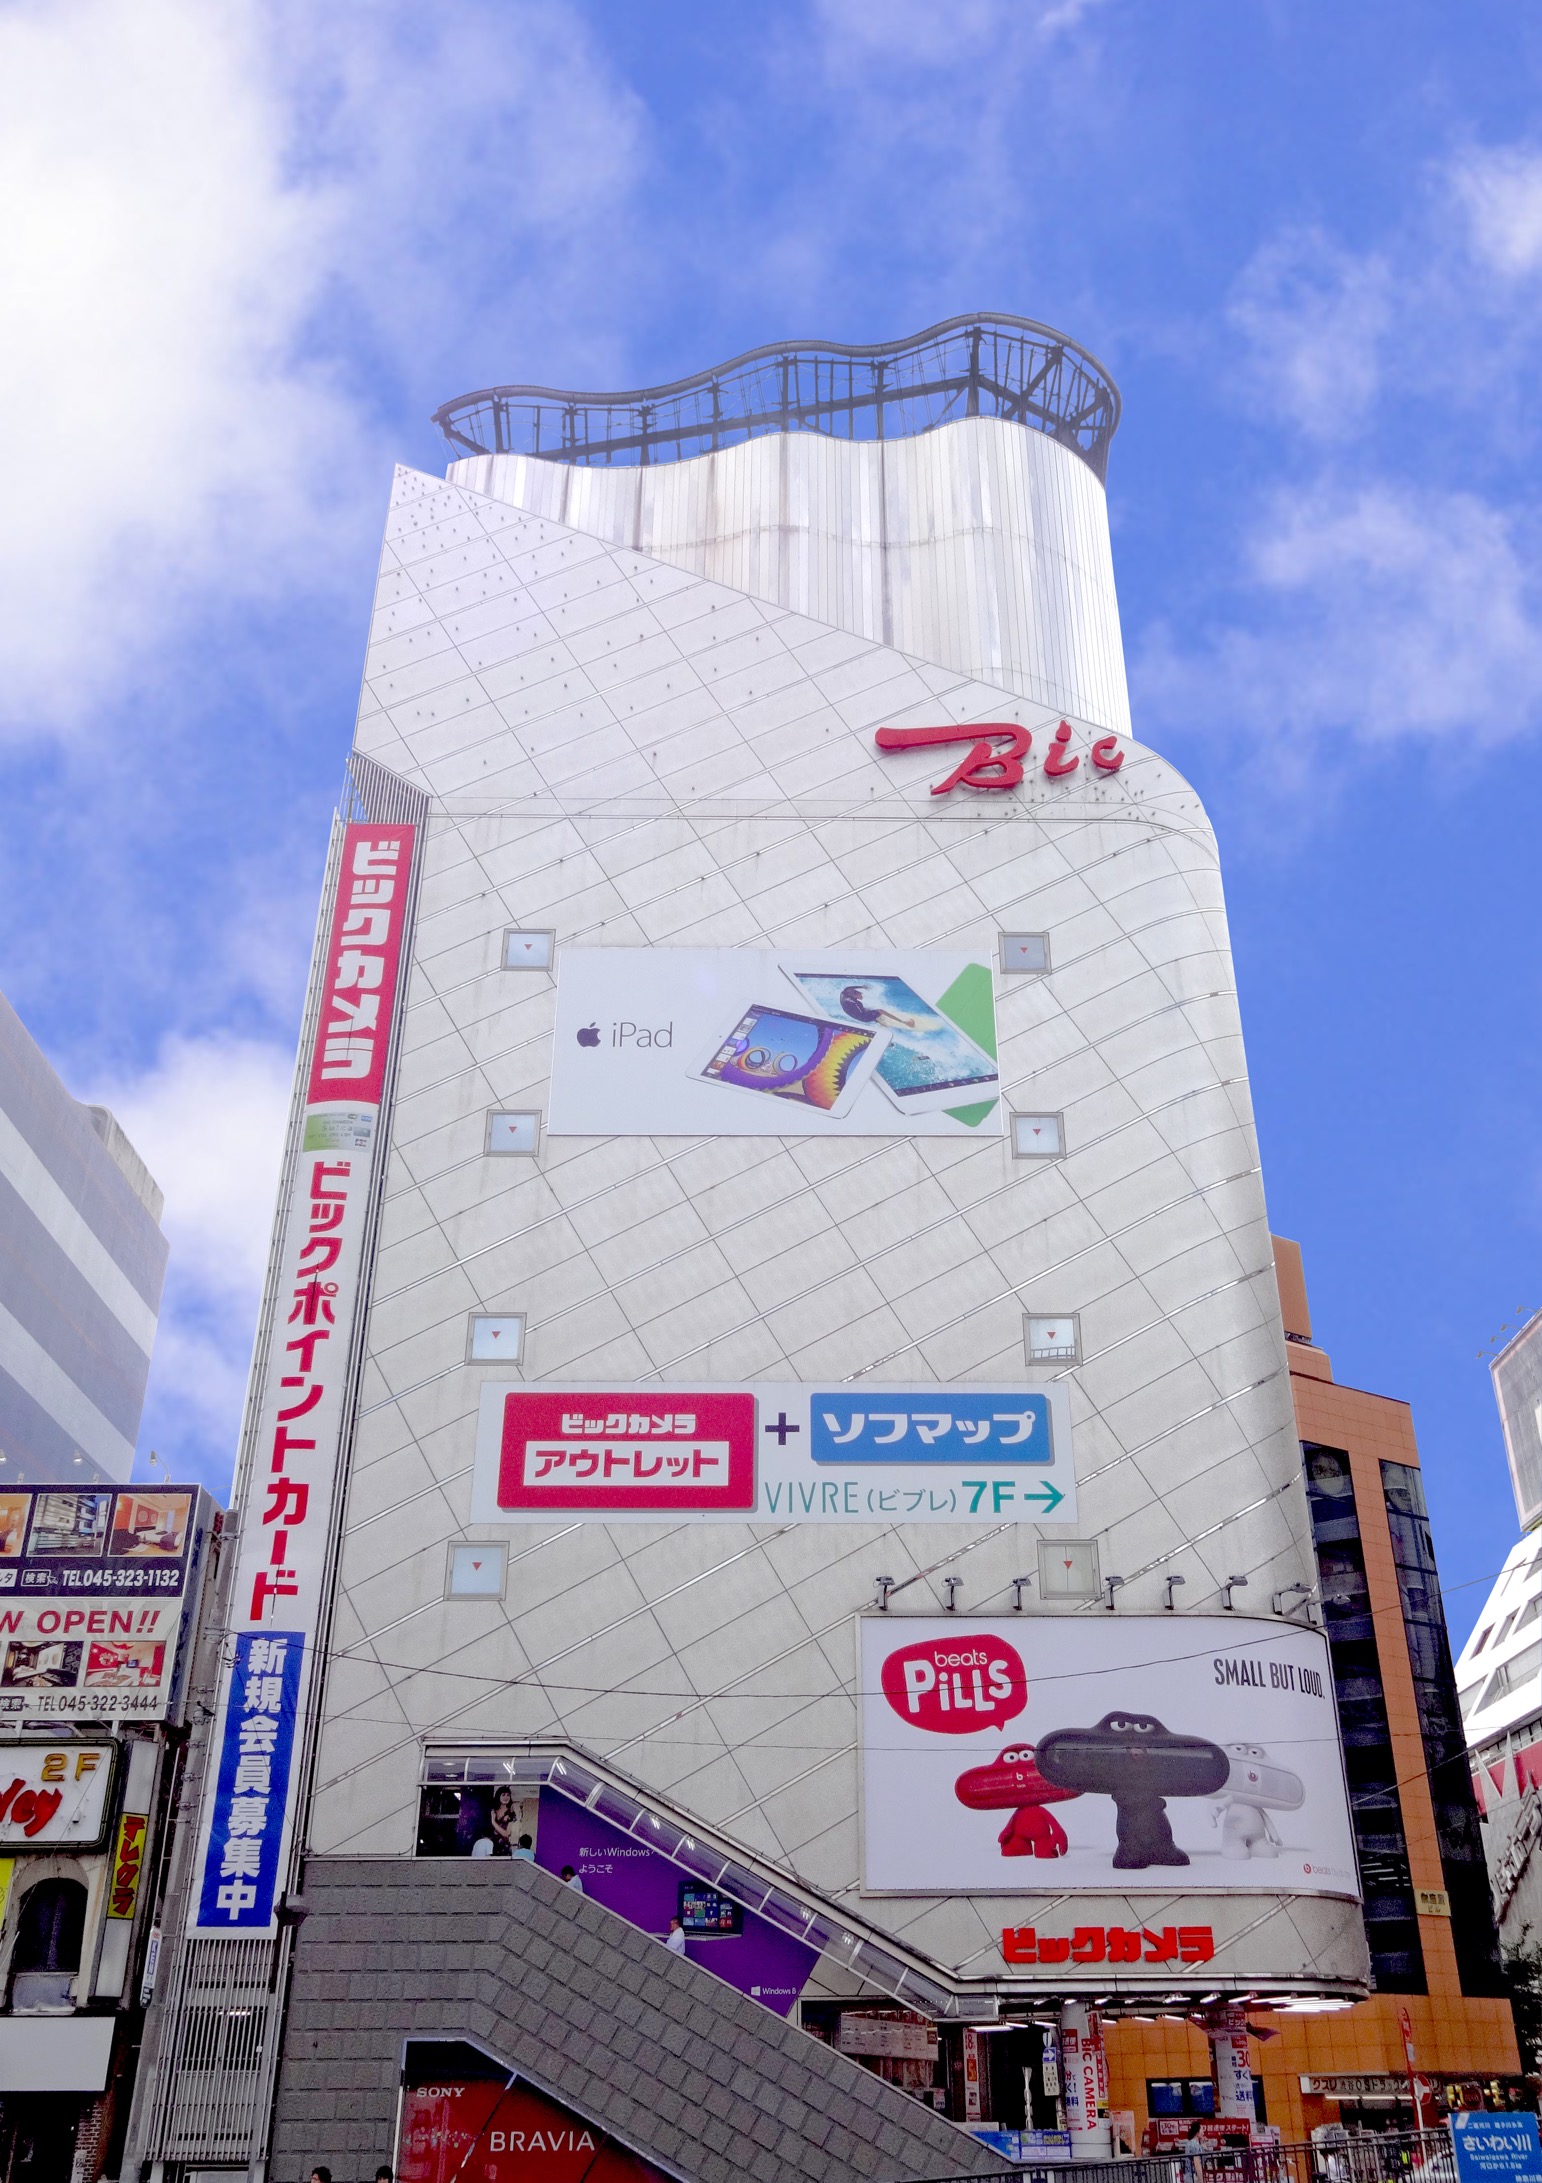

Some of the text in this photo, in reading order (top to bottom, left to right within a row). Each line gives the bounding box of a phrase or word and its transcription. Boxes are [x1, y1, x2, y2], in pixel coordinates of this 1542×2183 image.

[875, 719, 1125, 797] Bic
[320, 840, 400, 1081] ビックカメラ
[611, 1020, 674, 1048] iPad
[249, 1161, 351, 1621] ビックポイントカード
[561, 1413, 696, 1435] ビックカメラ
[822, 1411, 1036, 1445] ソフマップ
[535, 1449, 720, 1479] アウトレット
[764, 1481, 860, 1514] VIVRE
[961, 1480, 1016, 1514] 7F
[36, 1610, 161, 1634] OPEN!!
[934, 1649, 988, 1667] beats
[1213, 1658, 1326, 1700] SMALL BUT LOUD.
[41, 1753, 101, 1781] 2F
[216, 1638, 287, 1920] 新規会員募集中
[112, 1815, 146, 1916] テレクラ
[578, 1864, 614, 1874] ようこそ
[1002, 1926, 1215, 1964] ビックカメラ
[762, 1987, 791, 1995] Windows
[1081, 2038, 1094, 2063] BIC
[416, 2087, 466, 2099] SONY
[1083, 2066, 1098, 2131] CAMERA
[489, 2130, 596, 2152] BRAVIA
[1462, 2133, 1533, 2152] さいわい川
